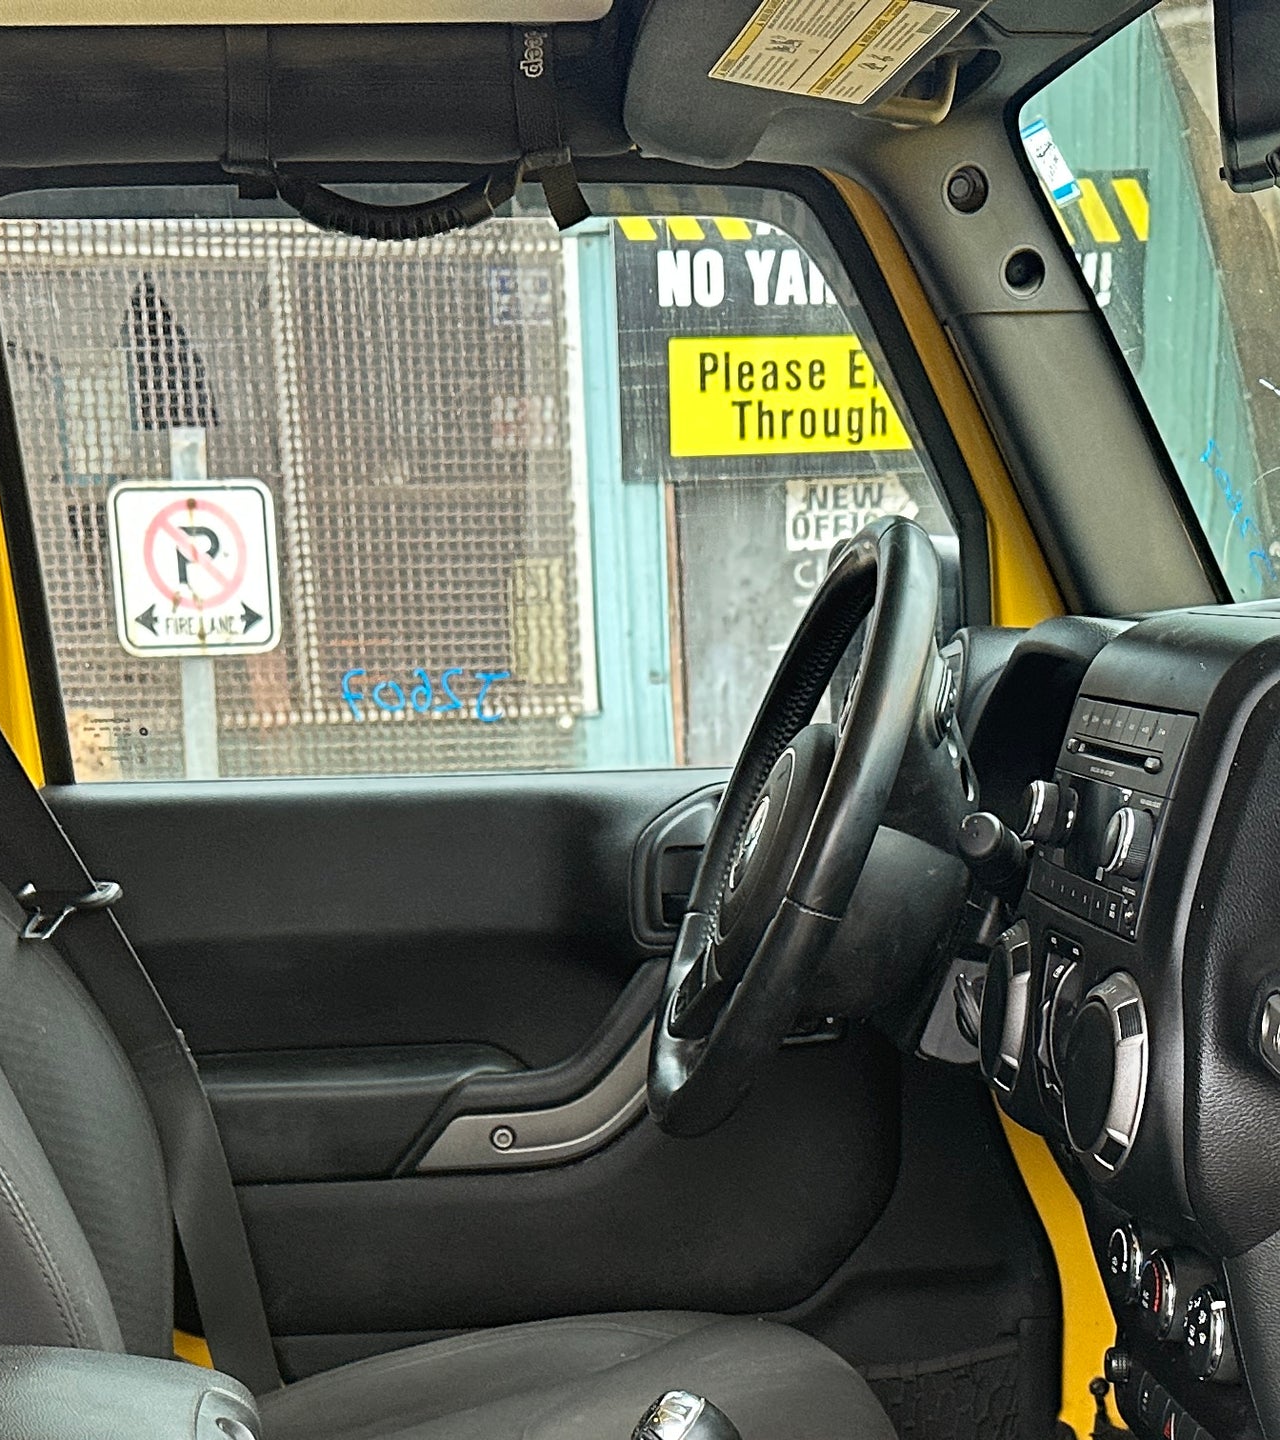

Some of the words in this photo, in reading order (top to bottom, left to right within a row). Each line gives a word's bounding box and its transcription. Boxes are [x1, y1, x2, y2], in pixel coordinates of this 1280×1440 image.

[656, 248, 725, 308] NO
[699, 352, 826, 393] Please
[731, 396, 888, 445] Through
[806, 481, 884, 510] NEW
[165, 616, 196, 636] FIRE
